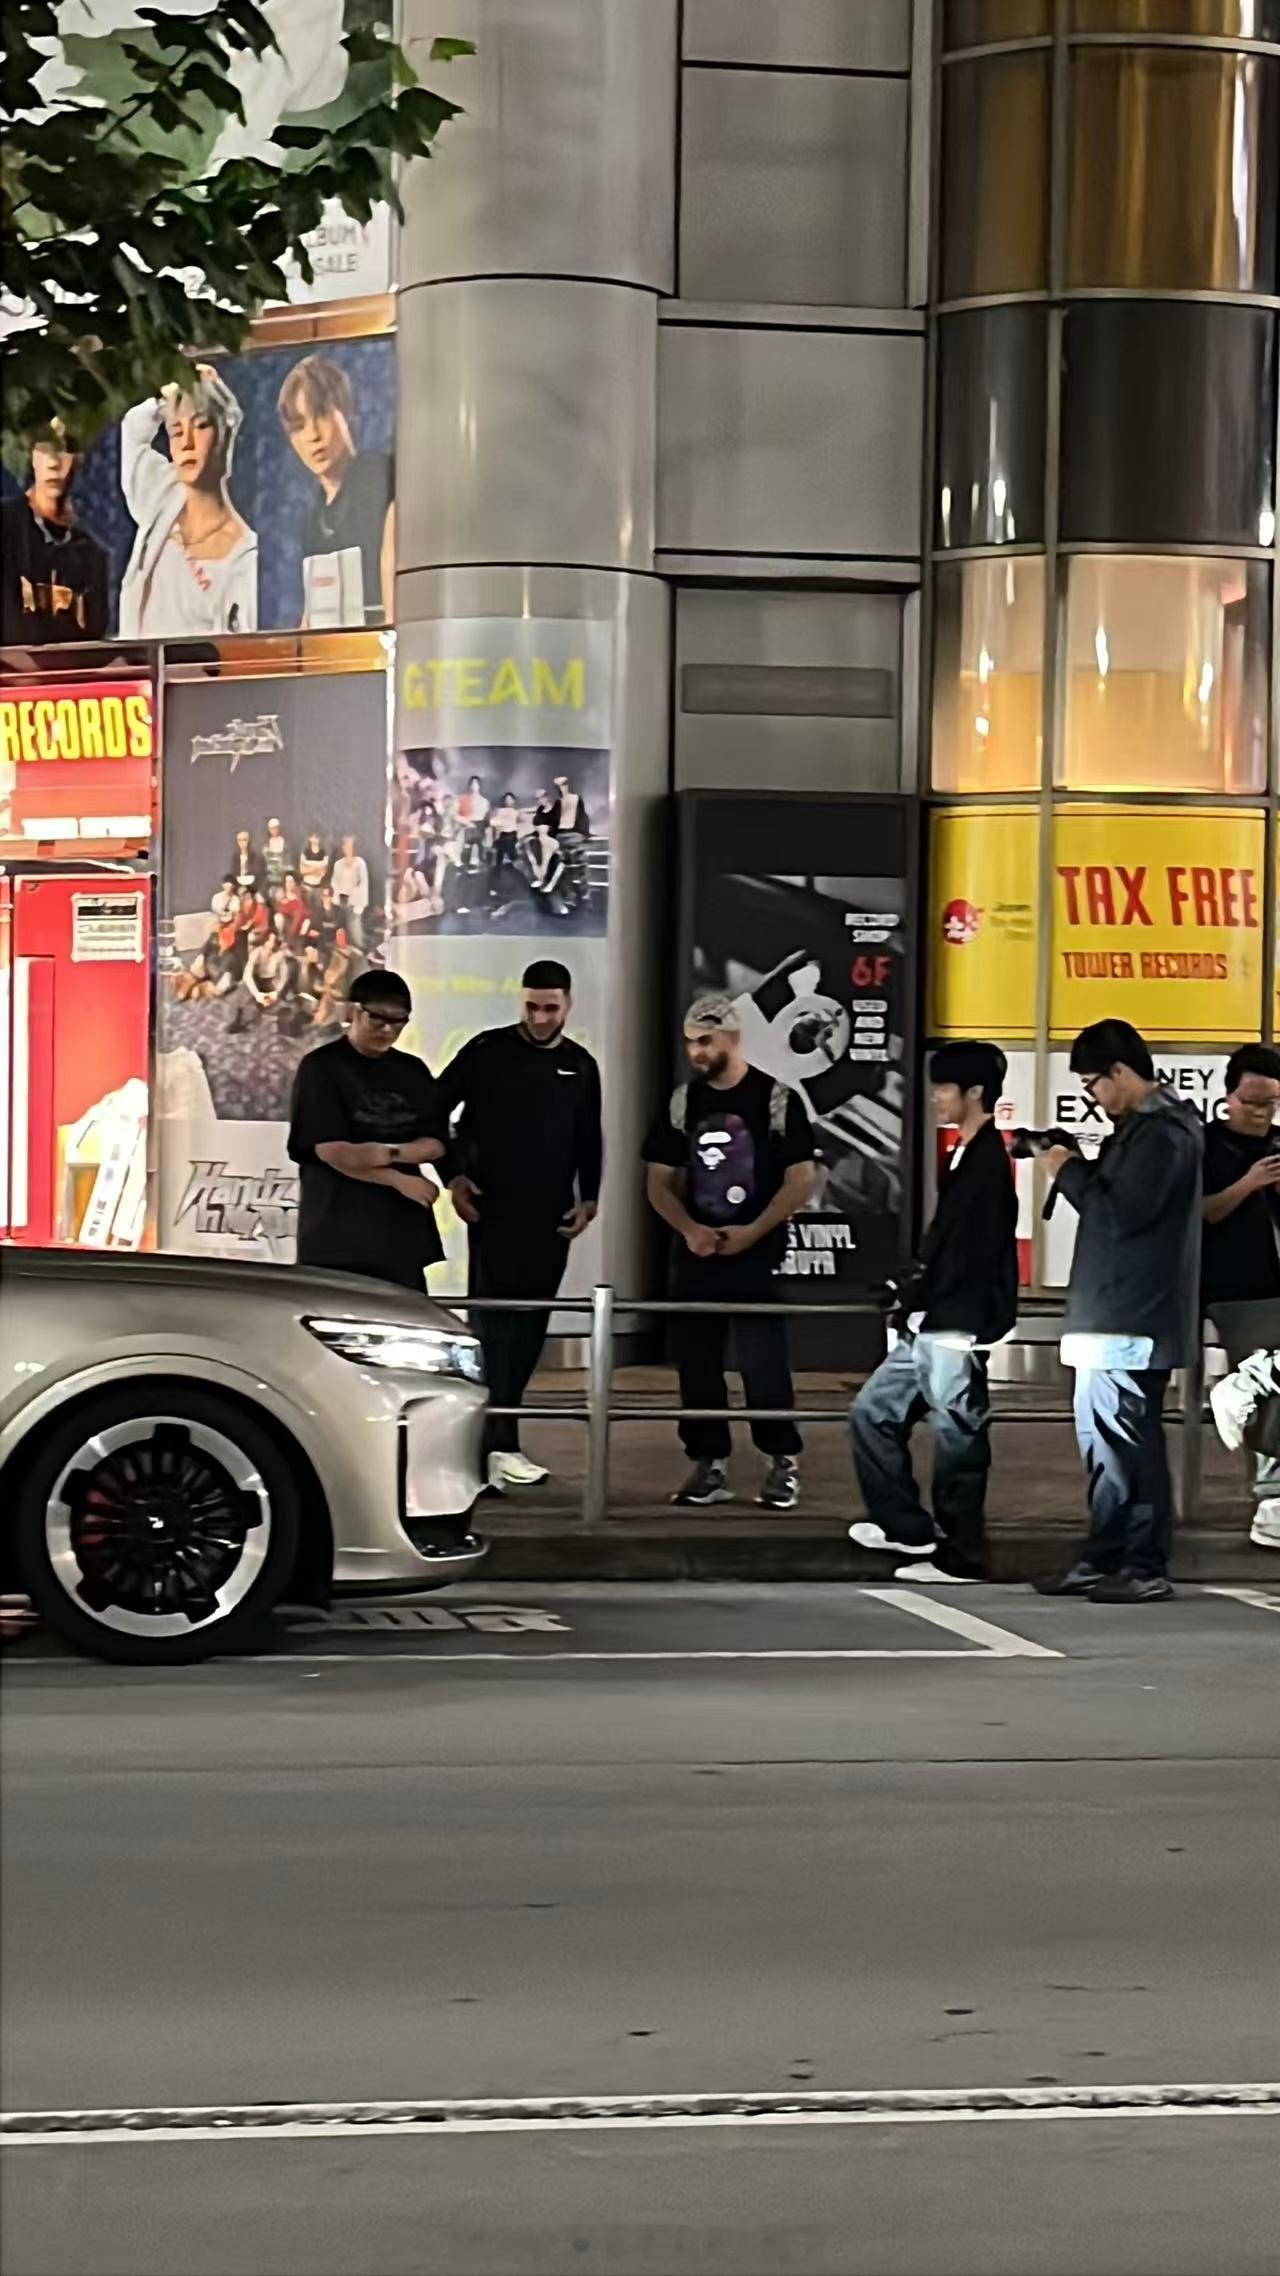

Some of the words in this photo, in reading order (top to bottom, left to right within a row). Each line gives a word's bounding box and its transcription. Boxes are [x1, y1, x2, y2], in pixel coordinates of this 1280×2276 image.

[0, 696, 152, 761] RECORDS
[1056, 866, 1153, 926] TAX
[1166, 867, 1258, 927] FREE
[850, 954, 891, 987] 6F
[1062, 952, 1134, 979] TOWER
[1140, 952, 1228, 979] RECORDS
[798, 1224, 856, 1248] VINYL
